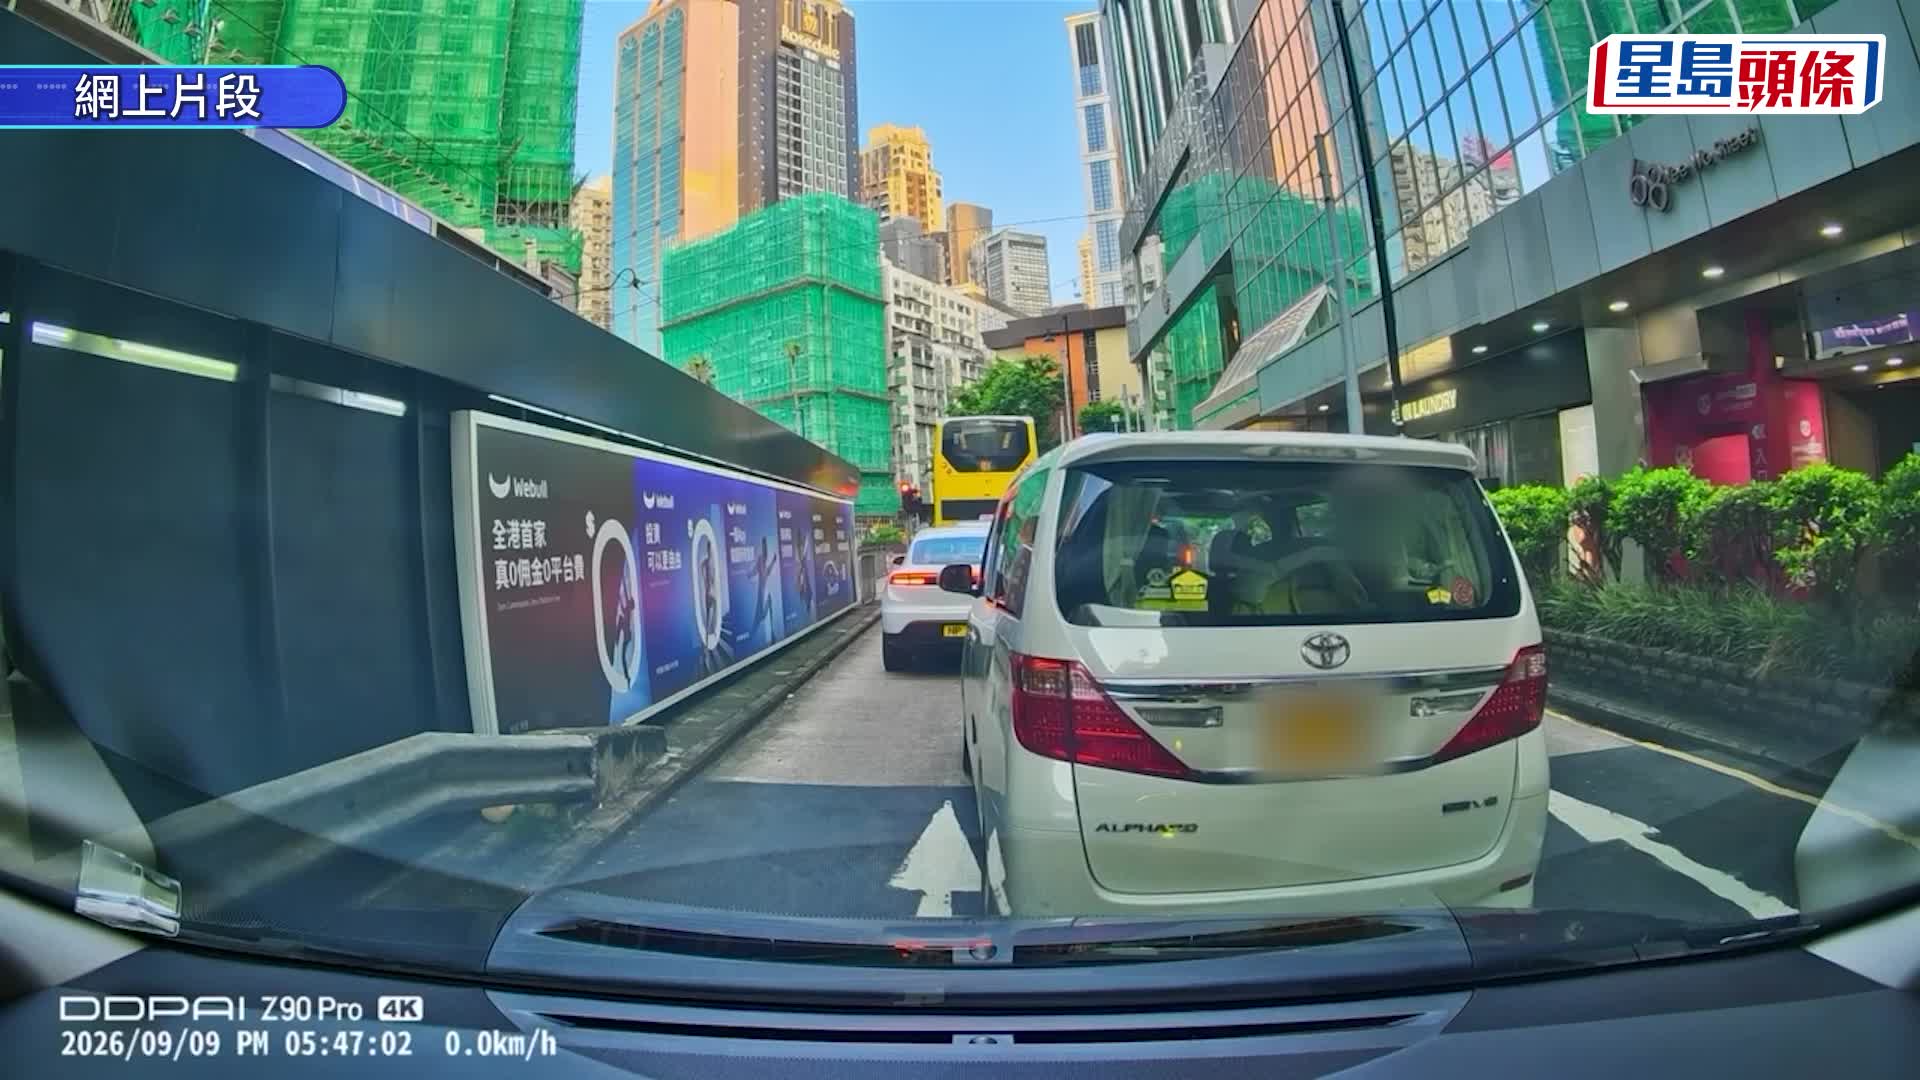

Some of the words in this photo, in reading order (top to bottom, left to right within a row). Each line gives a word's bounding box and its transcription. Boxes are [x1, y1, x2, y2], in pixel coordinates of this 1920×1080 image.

[781, 24, 840, 60] Rosedale
[1631, 158, 1669, 213] 68
[513, 477, 548, 498] Webull
[492, 519, 547, 550] 全港首家
[494, 553, 584, 590] 真0佣金0平台費
[1096, 823, 1199, 833] ALPHARD
